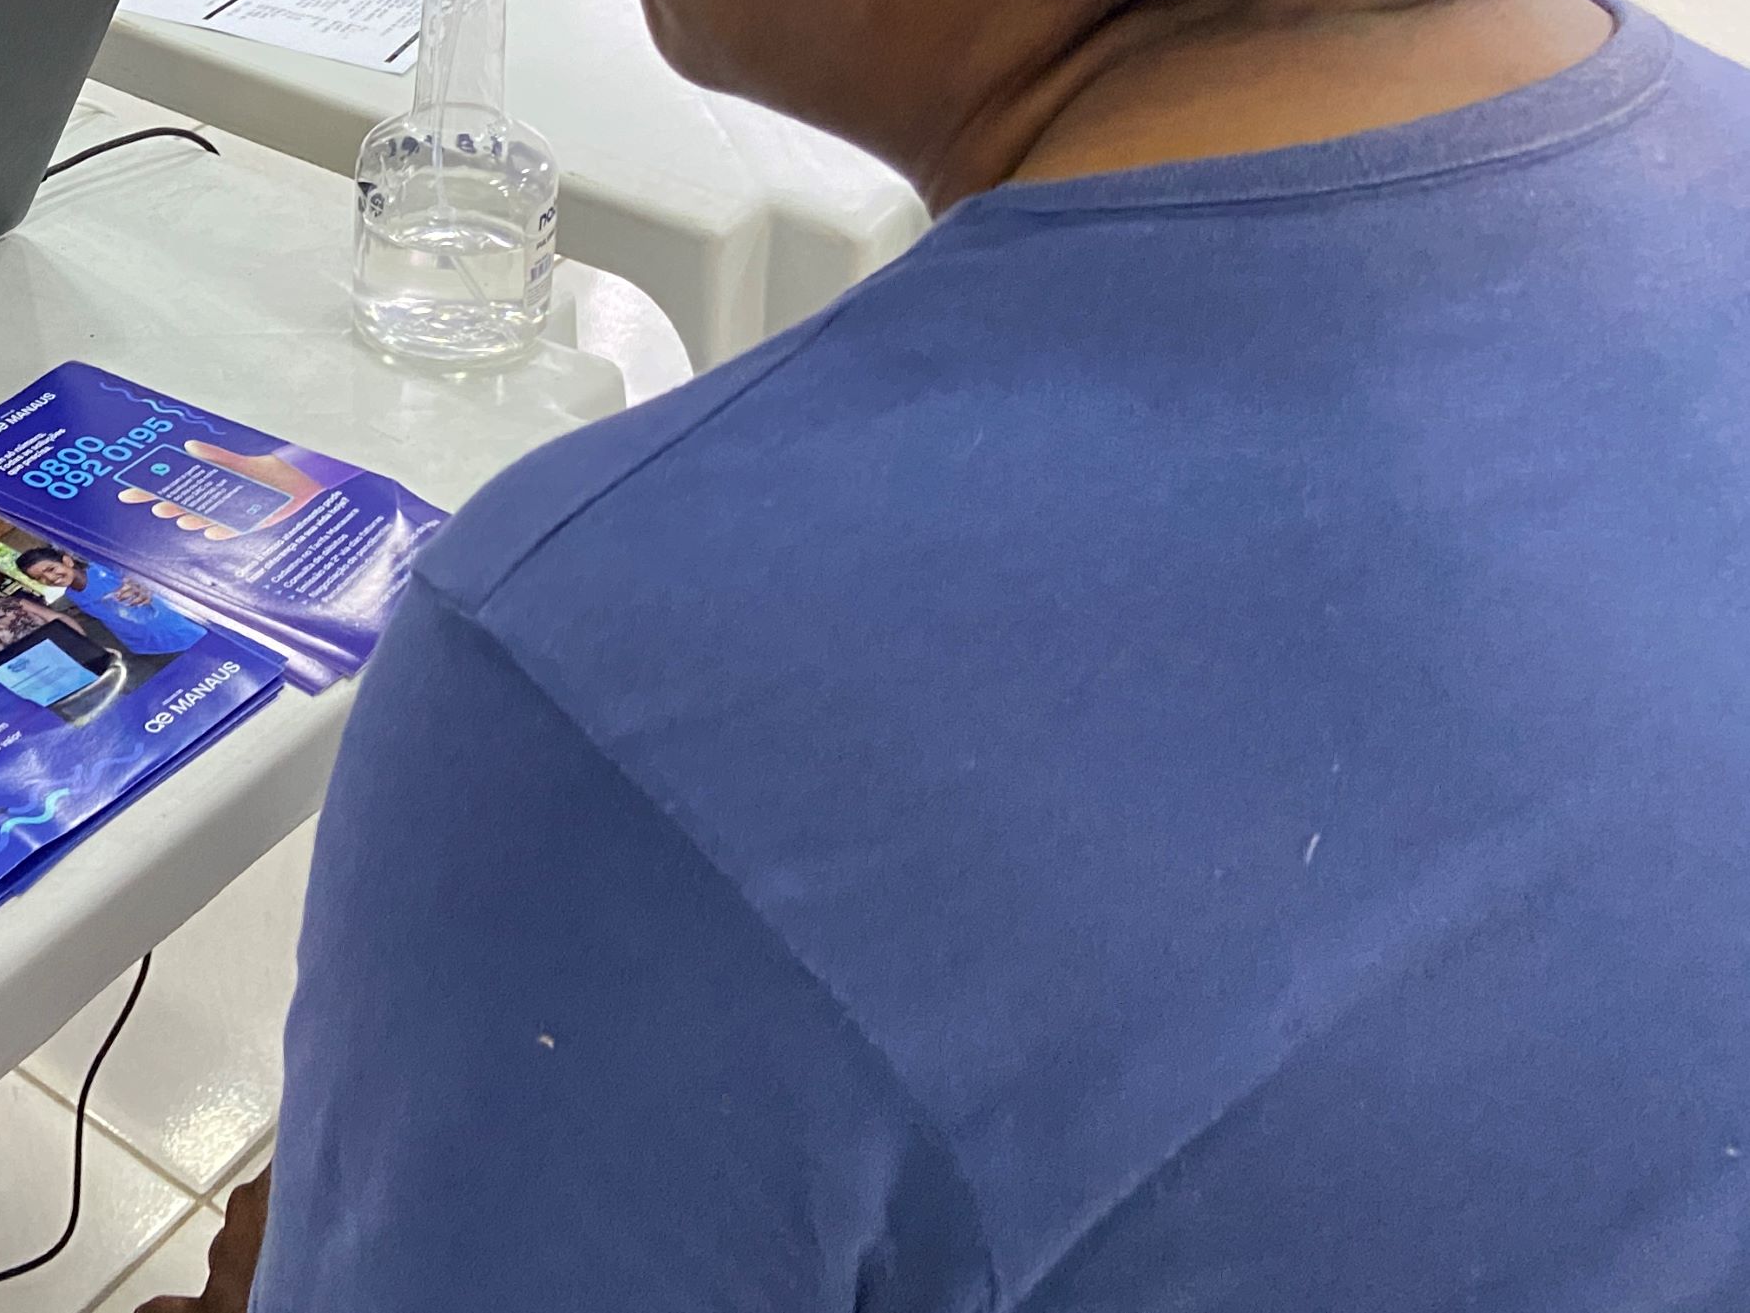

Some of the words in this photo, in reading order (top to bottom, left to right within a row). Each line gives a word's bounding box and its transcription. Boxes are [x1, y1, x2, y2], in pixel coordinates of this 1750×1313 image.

[4, 392, 56, 424] MANAUS
[7, 463, 24, 475] que
[22, 435, 105, 487] 0800
[47, 458, 114, 498] 092
[101, 416, 173, 461] 0195
[168, 661, 240, 714] MANAUS
[0, 730, 21, 747] valor
